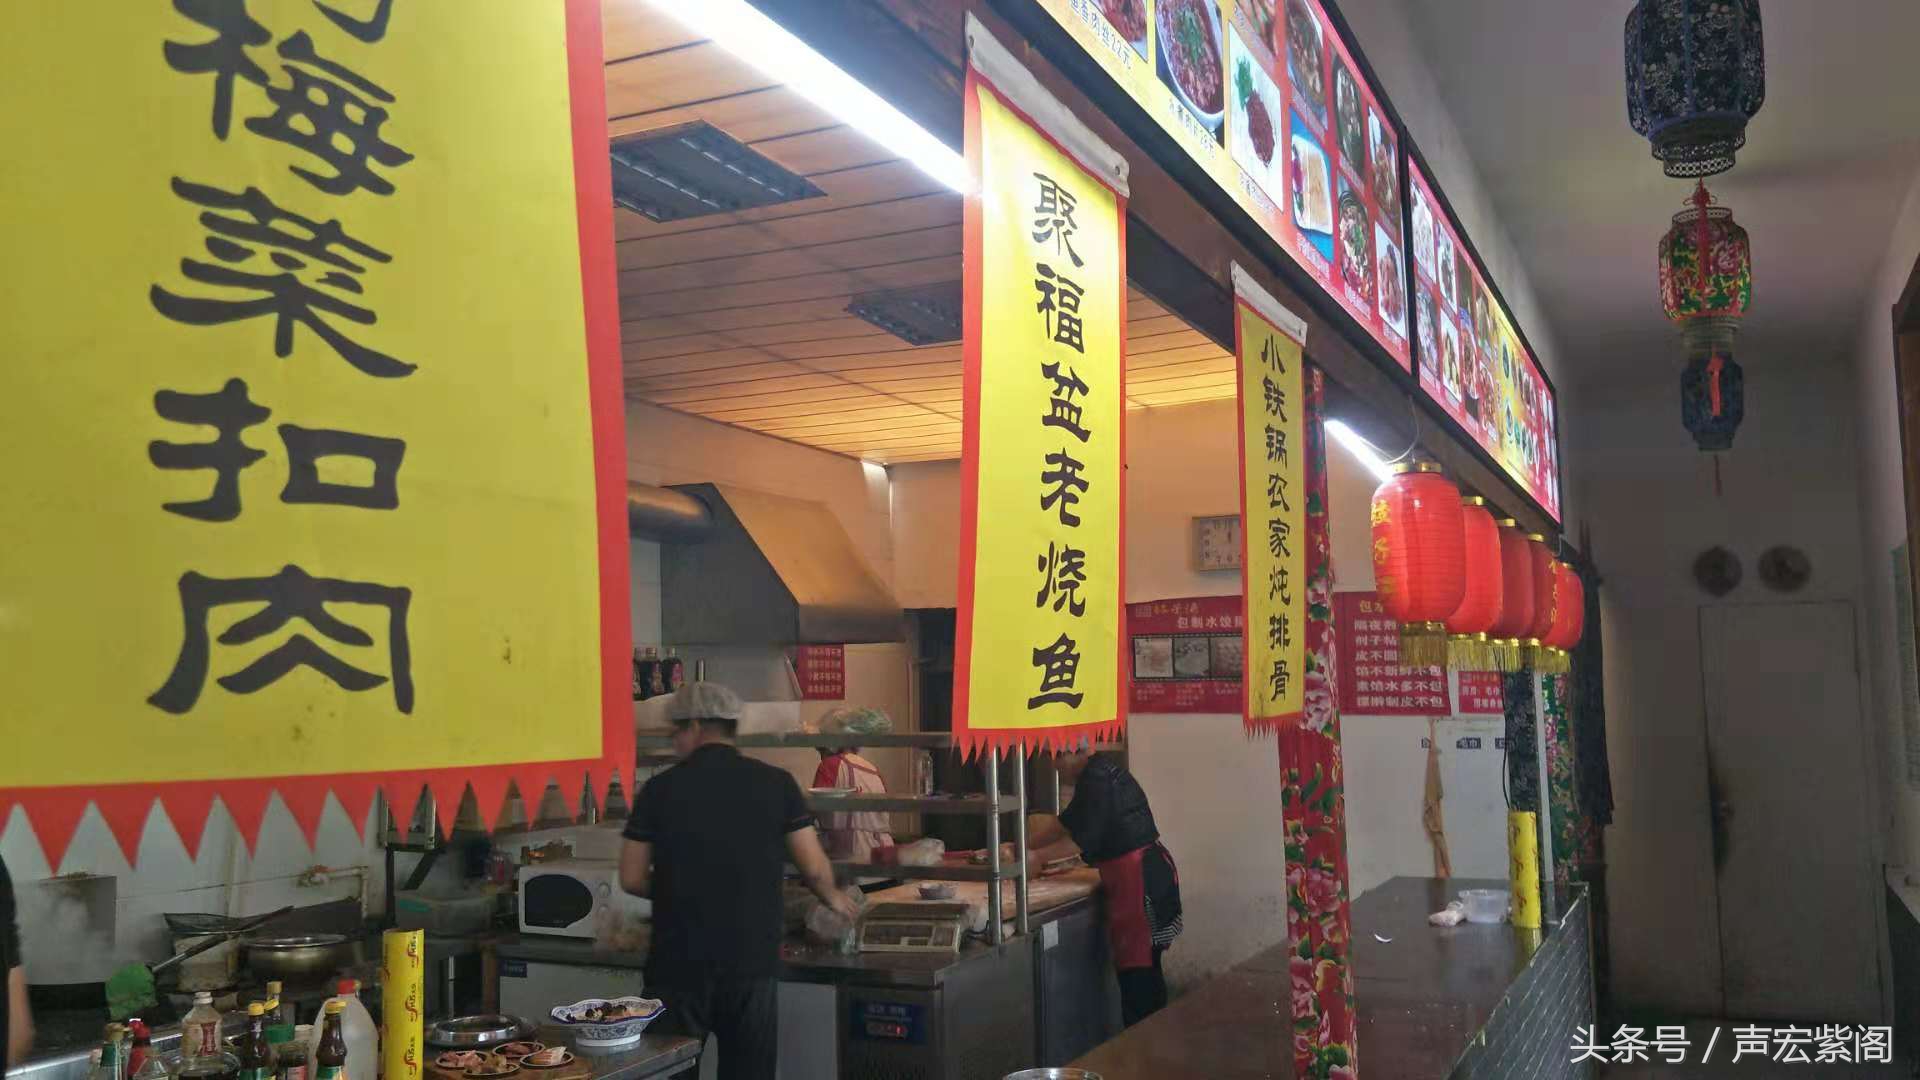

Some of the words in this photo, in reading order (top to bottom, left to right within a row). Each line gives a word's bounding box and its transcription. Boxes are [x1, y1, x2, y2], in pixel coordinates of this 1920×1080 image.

[146, 0, 417, 716] 梅菜扣肉
[1029, 172, 1090, 711] 聚福盆老烧鱼
[1261, 333, 1291, 702] 小铁锅农家炖排骨
